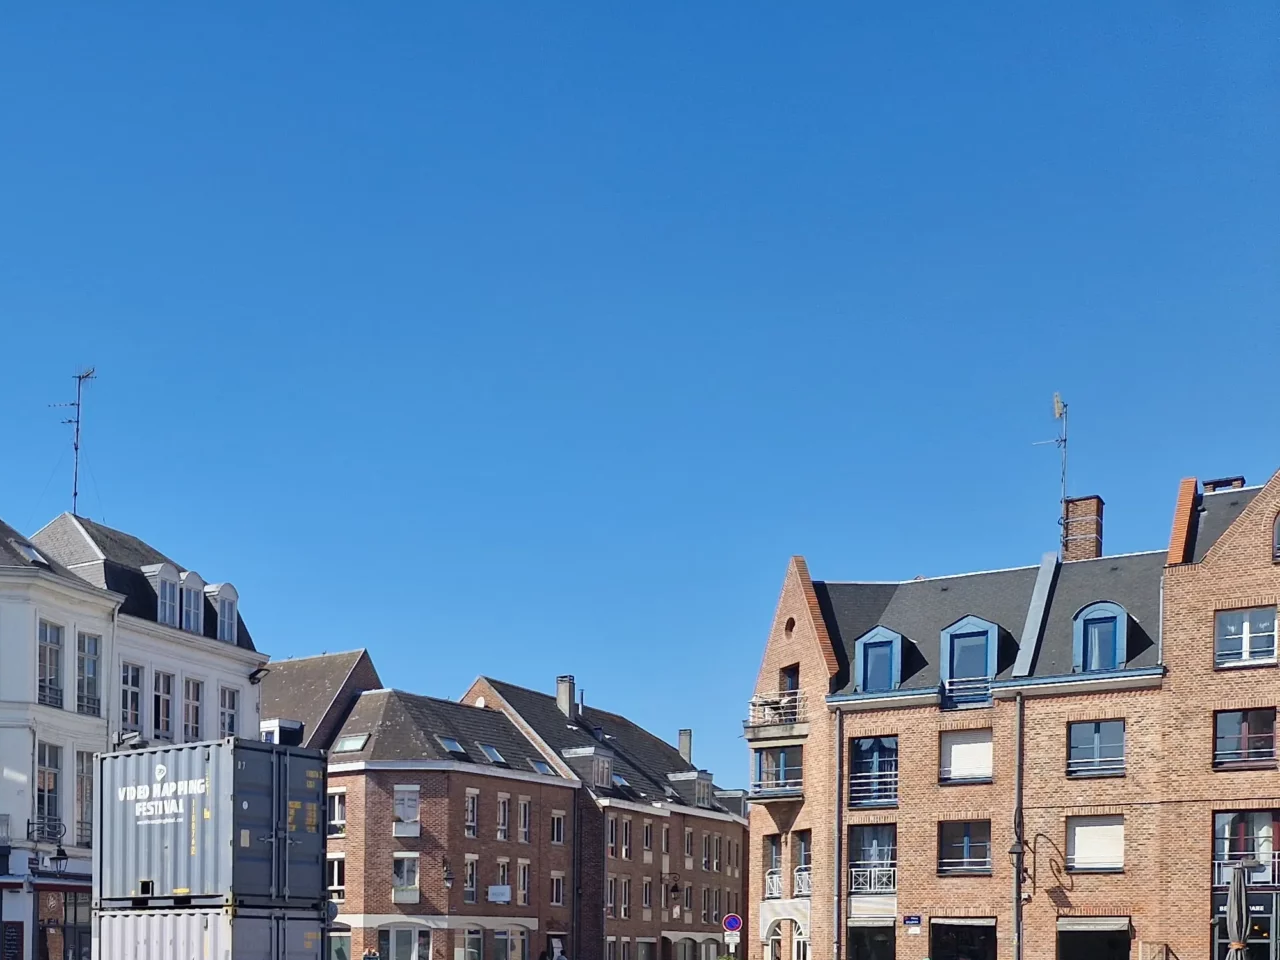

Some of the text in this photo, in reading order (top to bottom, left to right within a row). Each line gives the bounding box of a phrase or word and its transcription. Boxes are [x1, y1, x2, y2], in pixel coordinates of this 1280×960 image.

[118, 785, 150, 802] VIDEO
[152, 779, 206, 798] MAPPING
[135, 799, 184, 816] FESTIVAL
